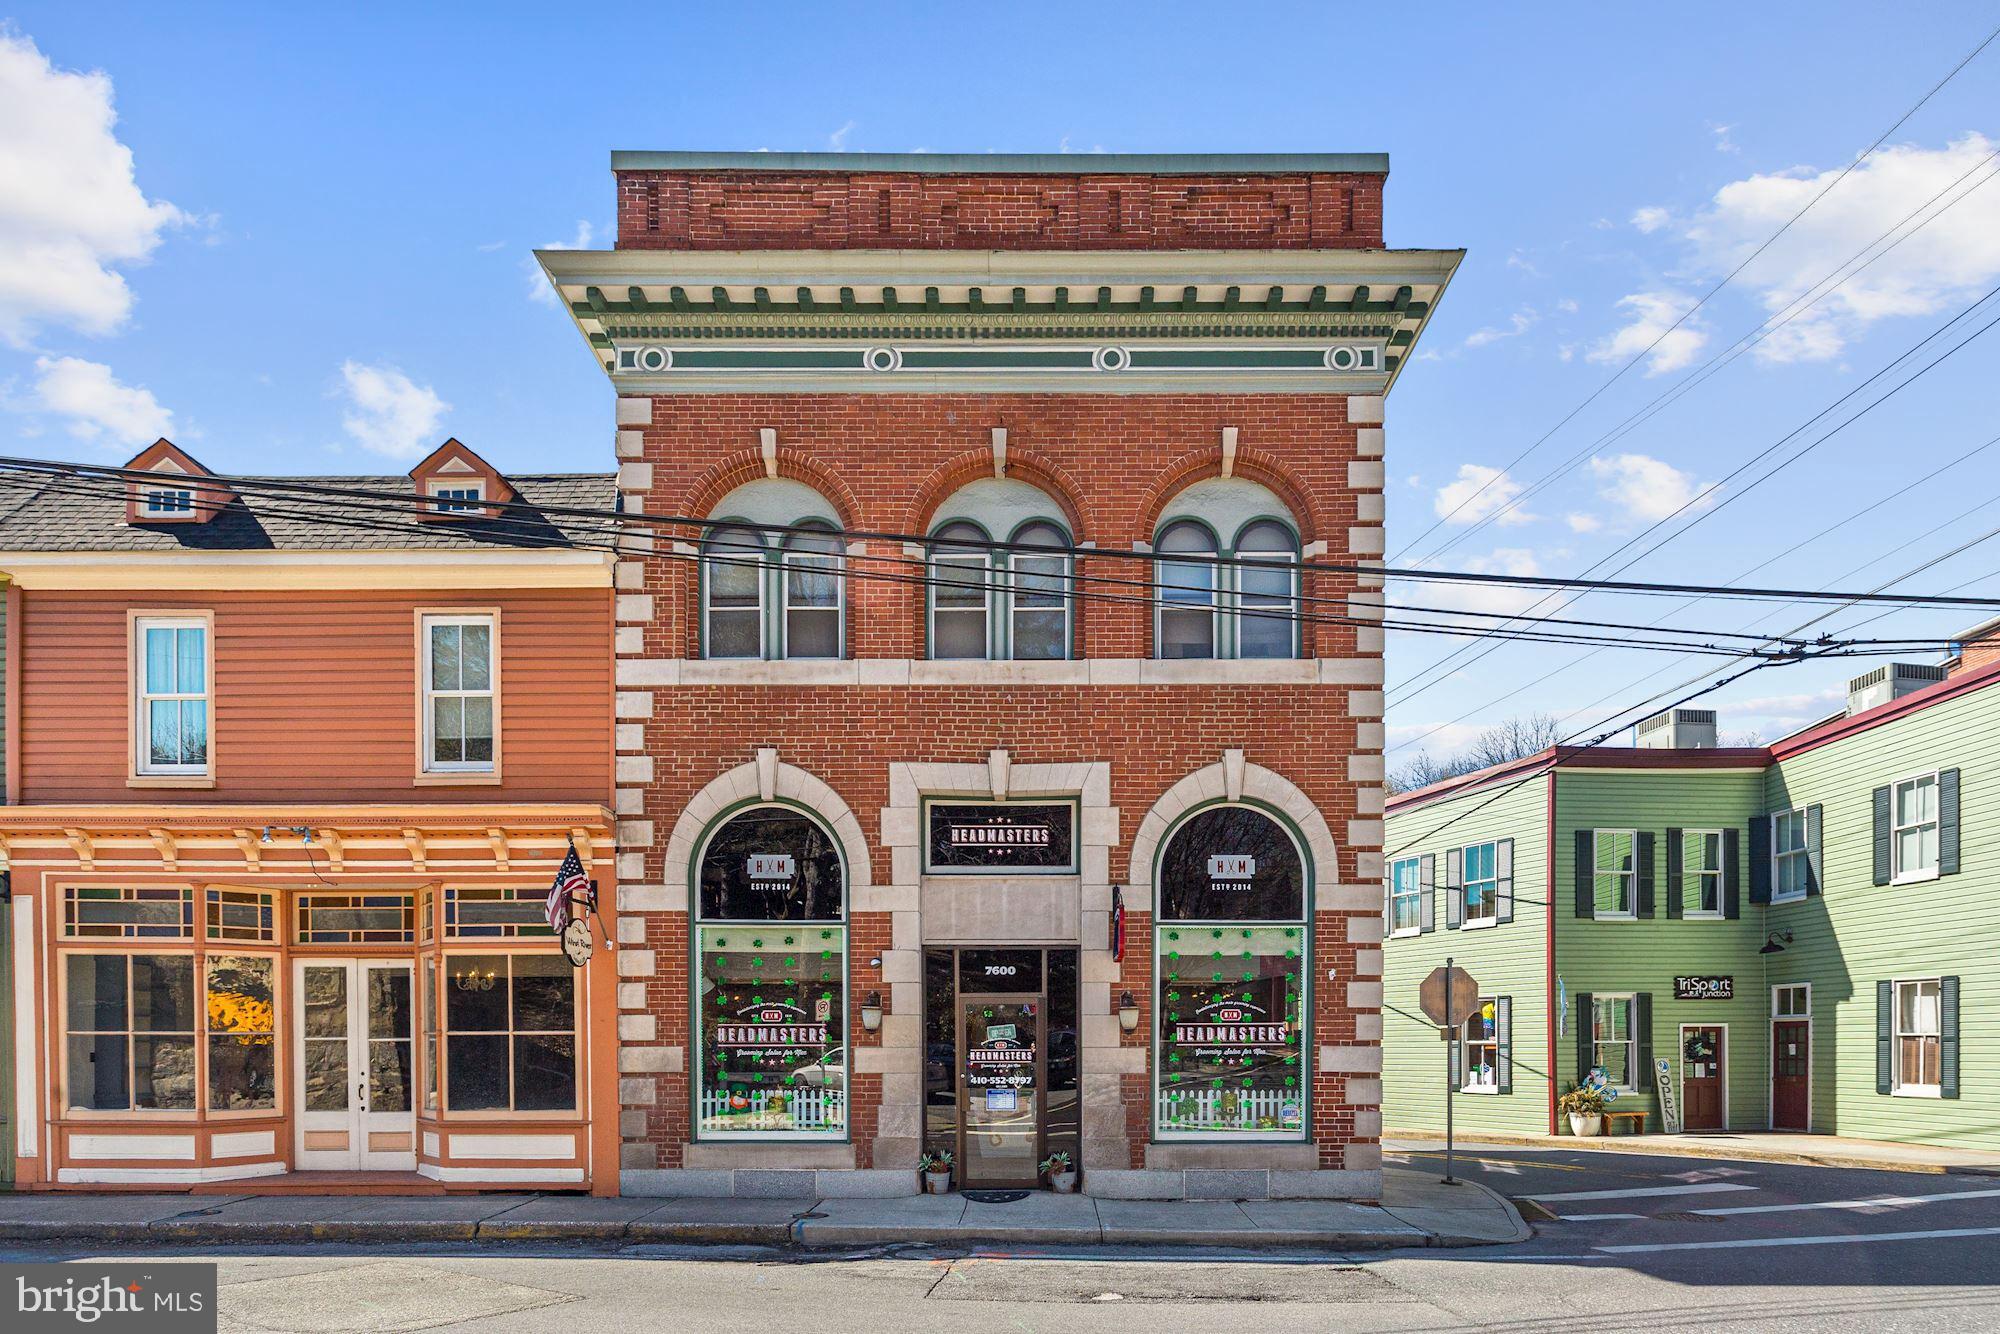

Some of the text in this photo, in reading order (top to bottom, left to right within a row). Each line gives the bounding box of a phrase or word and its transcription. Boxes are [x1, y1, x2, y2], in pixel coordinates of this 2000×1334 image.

[951, 828, 1049, 842] HEADMASTERS
[985, 966, 1016, 976] 7600
[1677, 977, 1730, 993] TriSport
[718, 1027, 826, 1042] HEADMASTERS
[1176, 1027, 1285, 1042] HEADMASTERS
[970, 1052, 1032, 1060] HEADMASTERS
[970, 1076, 1032, 1085] 410-552-8797
[1660, 1075, 1675, 1121] OPEN
